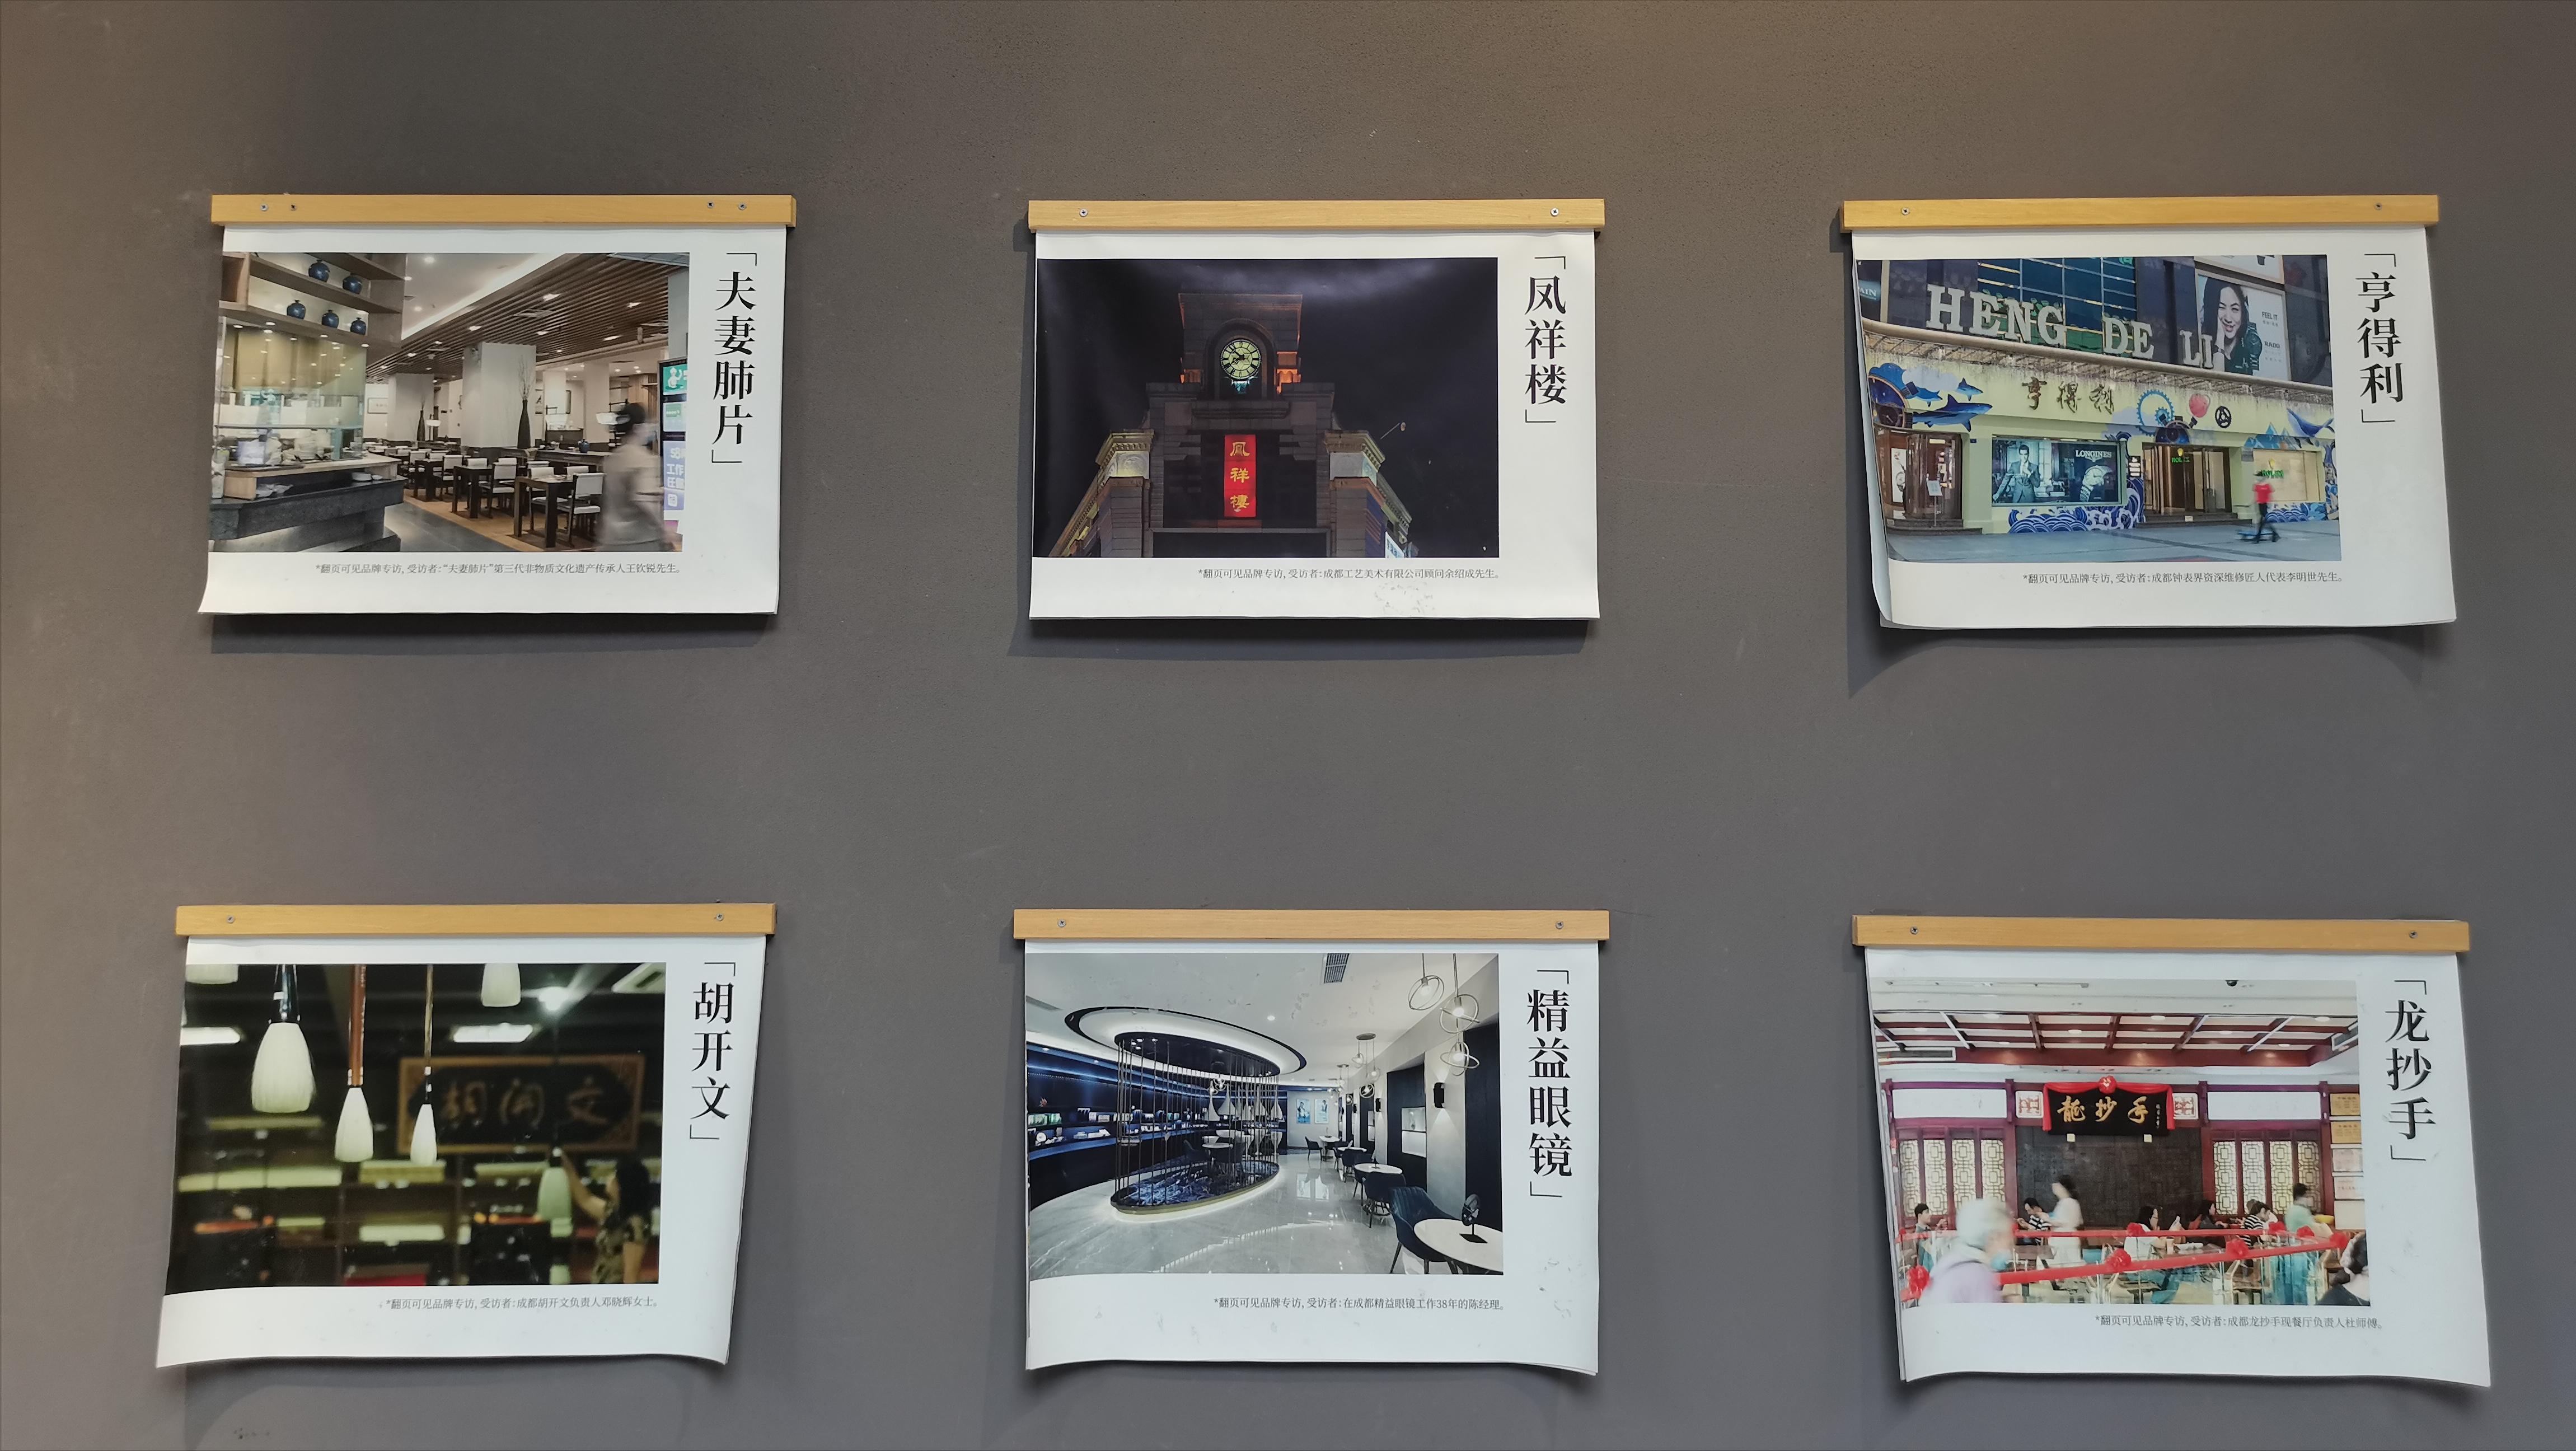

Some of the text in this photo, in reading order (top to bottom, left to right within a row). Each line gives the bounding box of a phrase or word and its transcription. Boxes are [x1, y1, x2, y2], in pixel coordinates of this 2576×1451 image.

[712, 253, 757, 463] 「夫妻肺片」
[1525, 256, 1567, 423] 「凤祥楼」
[1926, 284, 2214, 369] HENG DE LI
[2262, 311, 2273, 320] FEEL
[2355, 254, 2403, 423] 「亨得利」
[2076, 450, 2112, 458] LONGINES
[690, 962, 736, 1140] 「胡开文」
[1527, 970, 1572, 1197] 「精益眼镜」
[2385, 980, 2436, 1161] 「龙抄手」
